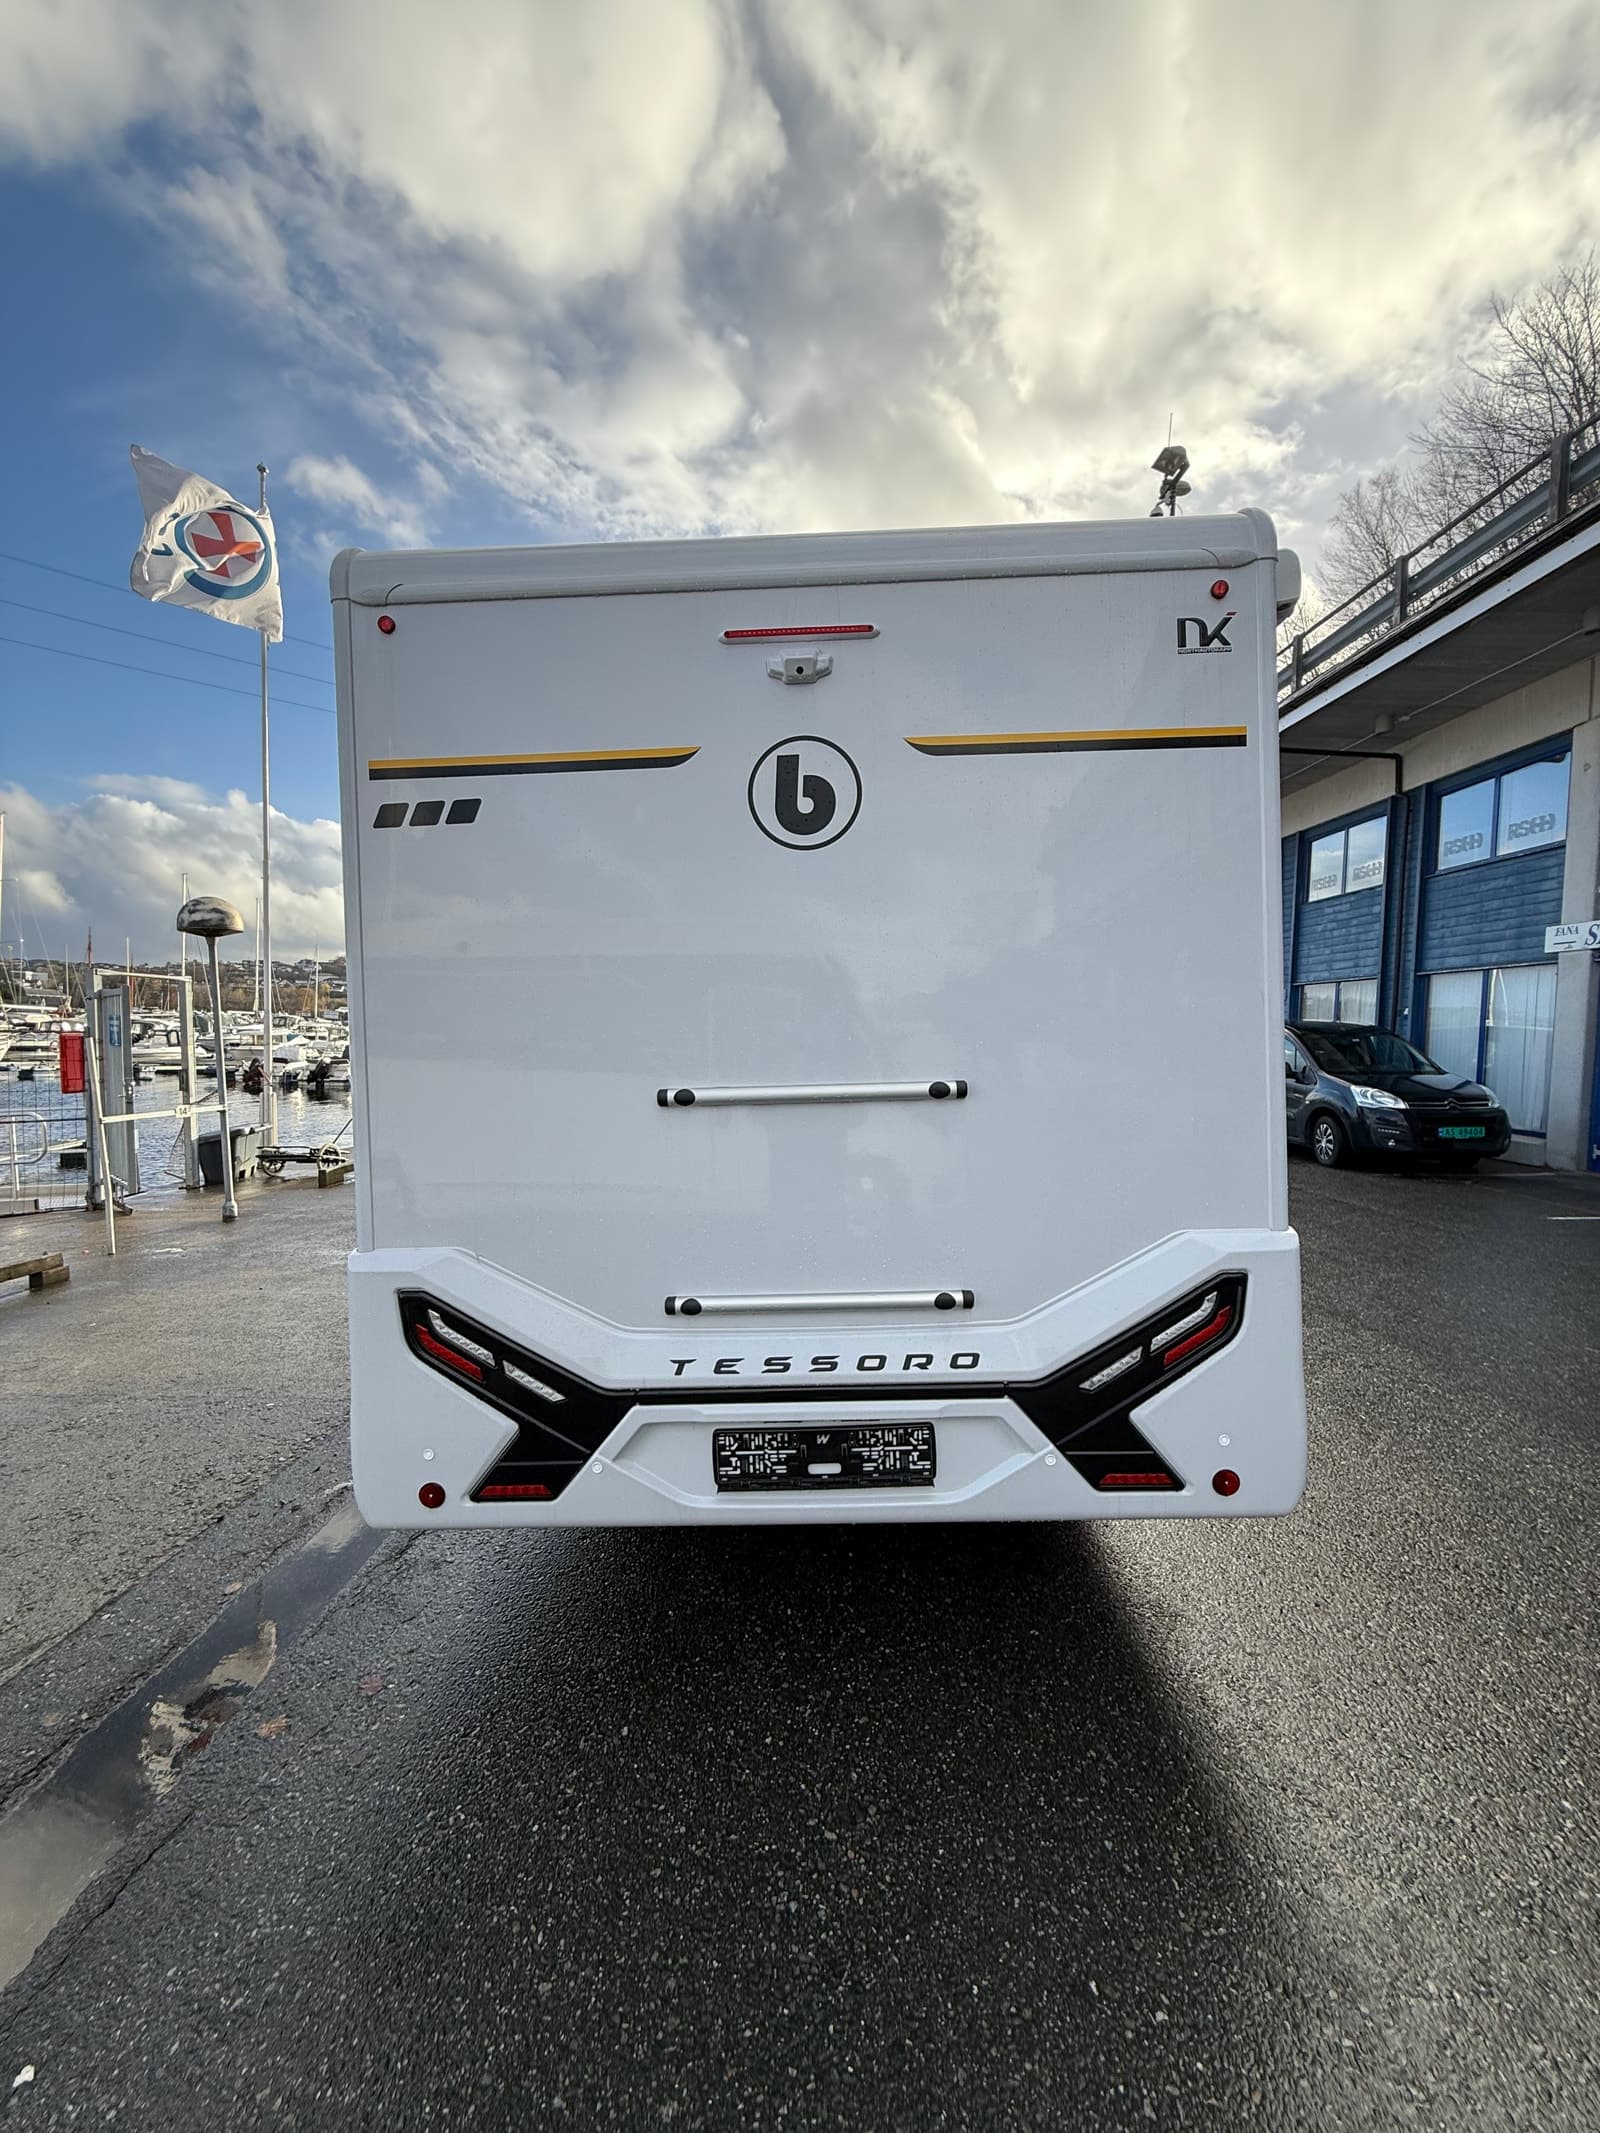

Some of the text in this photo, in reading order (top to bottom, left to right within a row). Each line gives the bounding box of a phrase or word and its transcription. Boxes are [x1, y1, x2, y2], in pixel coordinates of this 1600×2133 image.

[775, 754, 836, 836] b
[1555, 924, 1600, 945] FANA S
[178, 1107, 187, 1115] 14
[669, 1352, 981, 1376] TESSORO
